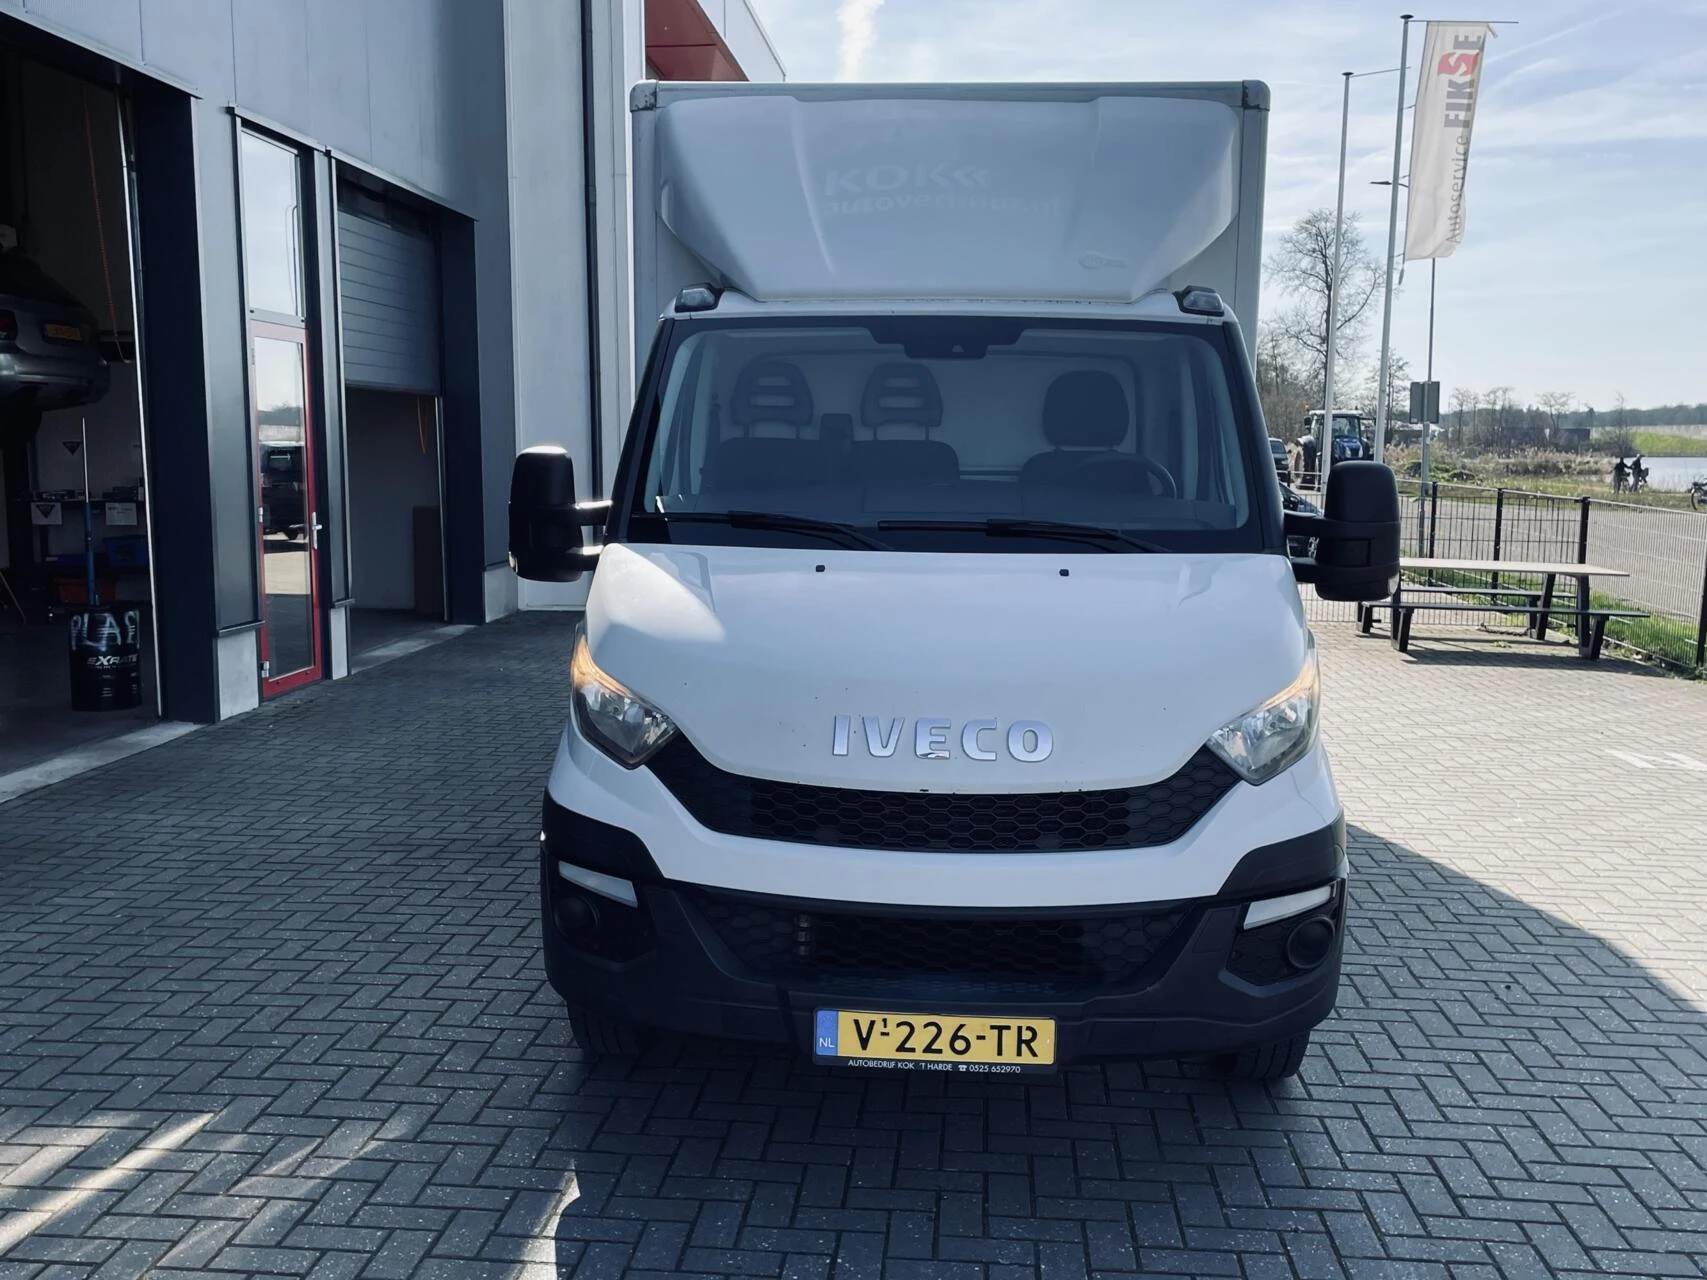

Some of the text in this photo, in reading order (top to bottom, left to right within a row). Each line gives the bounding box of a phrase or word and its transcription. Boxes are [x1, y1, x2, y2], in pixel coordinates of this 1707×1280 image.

[1438, 34, 1482, 244] Autoservice FIKSE
[832, 714, 1054, 762] IVECO
[819, 1038, 835, 1048] NL
[848, 1059, 896, 1070] AUTOBEDRIJF
[897, 1061, 915, 1070] KOK
[926, 1062, 953, 1071] HARDE
[969, 1064, 989, 1073] 0525
[990, 1065, 1021, 1074] 652970
